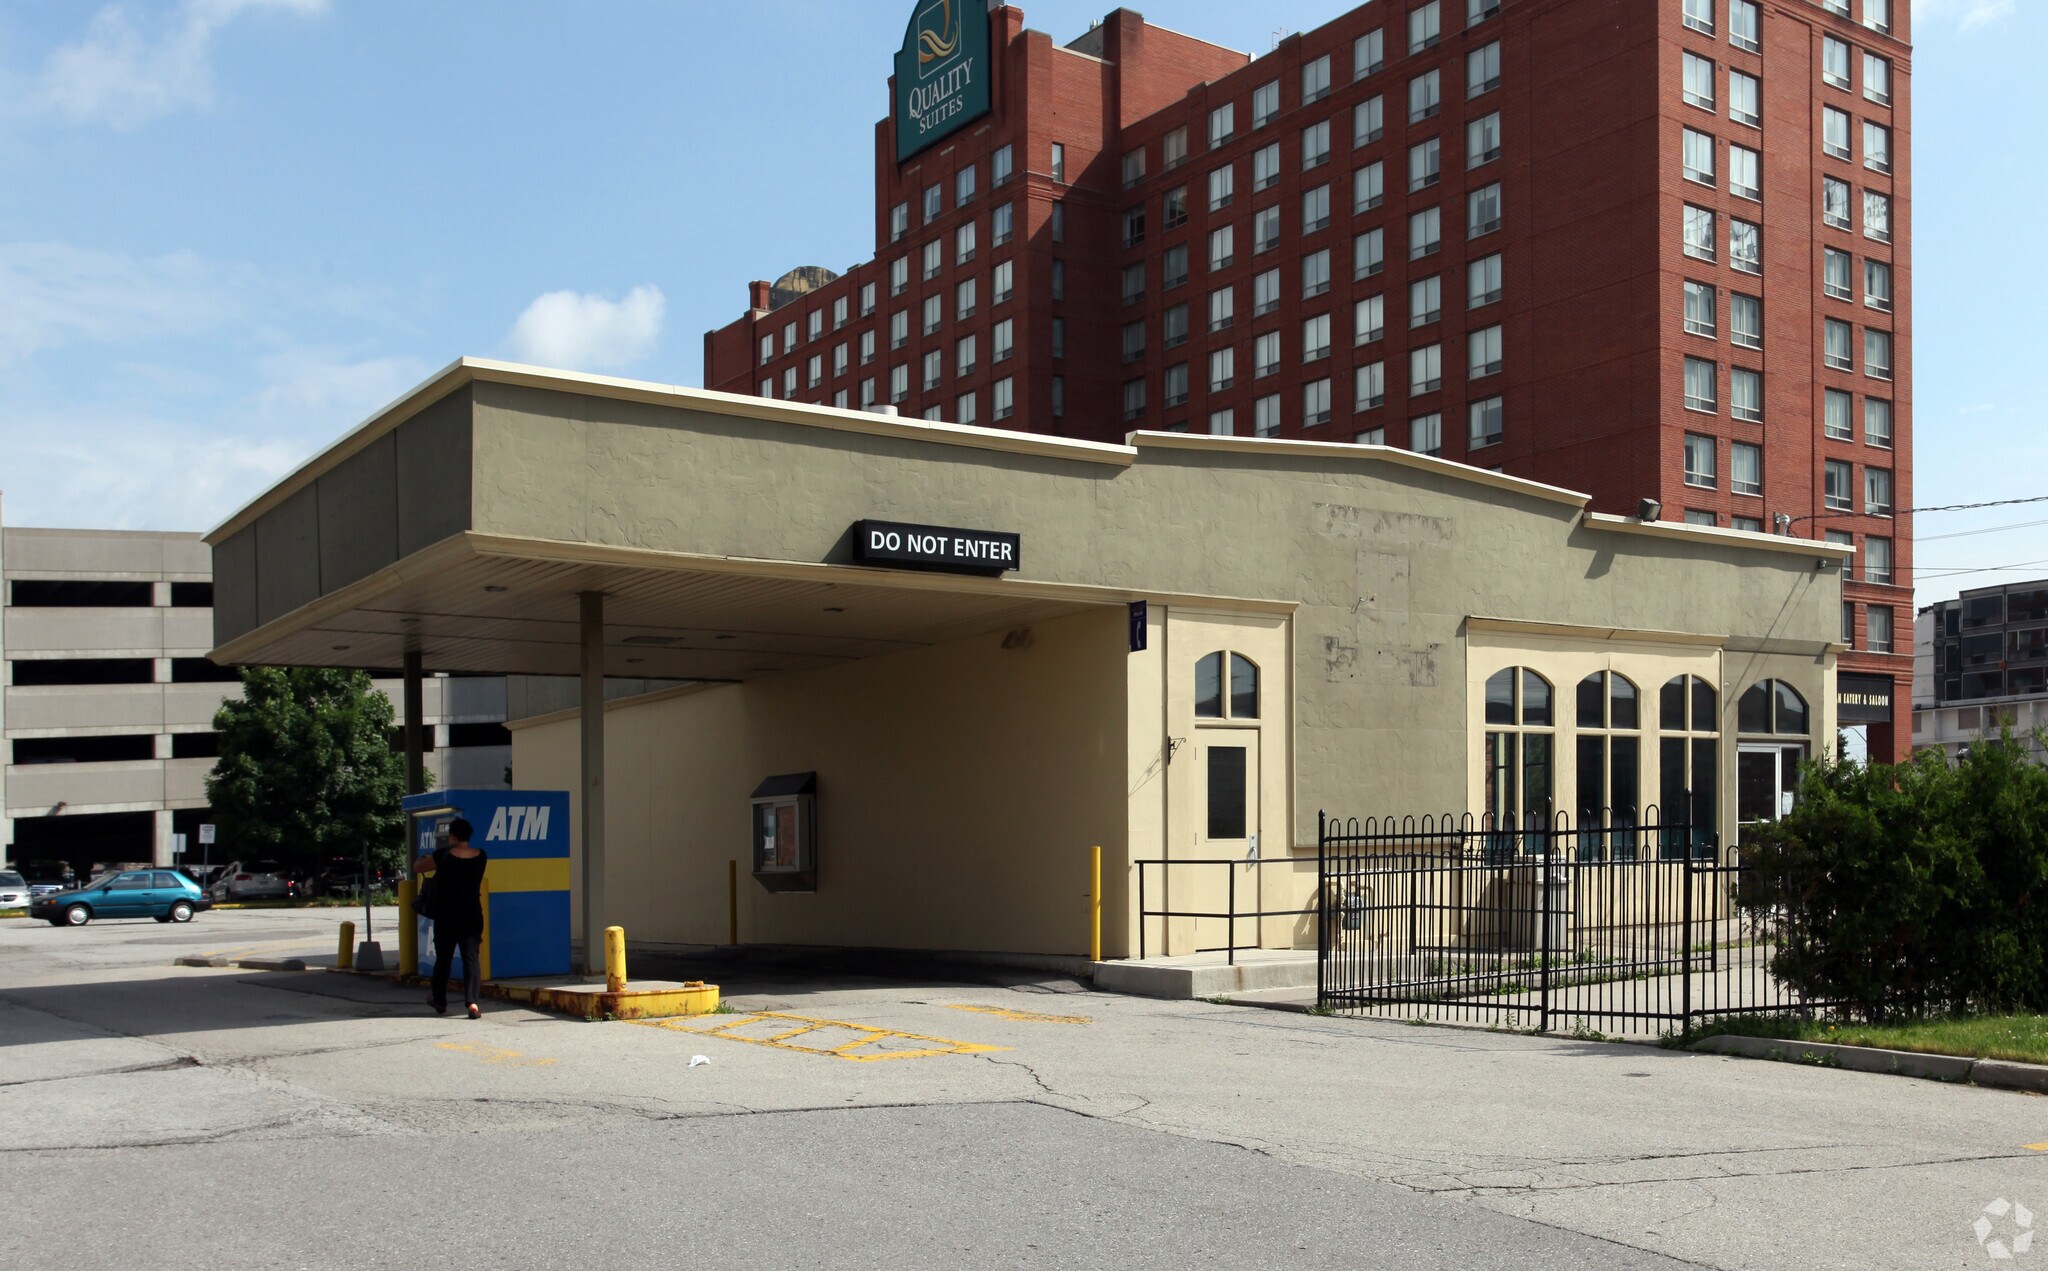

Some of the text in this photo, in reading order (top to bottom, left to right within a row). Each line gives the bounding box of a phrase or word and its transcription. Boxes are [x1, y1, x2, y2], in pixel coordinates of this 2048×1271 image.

[909, 57, 974, 119] QUALITY
[919, 95, 964, 134] SUITES
[871, 530, 1012, 561] DO NOT ENTER
[1843, 693, 1861, 704] EATERY
[1869, 694, 1888, 706] SALOON
[485, 806, 551, 841] ATM
[419, 831, 437, 850] ATM
